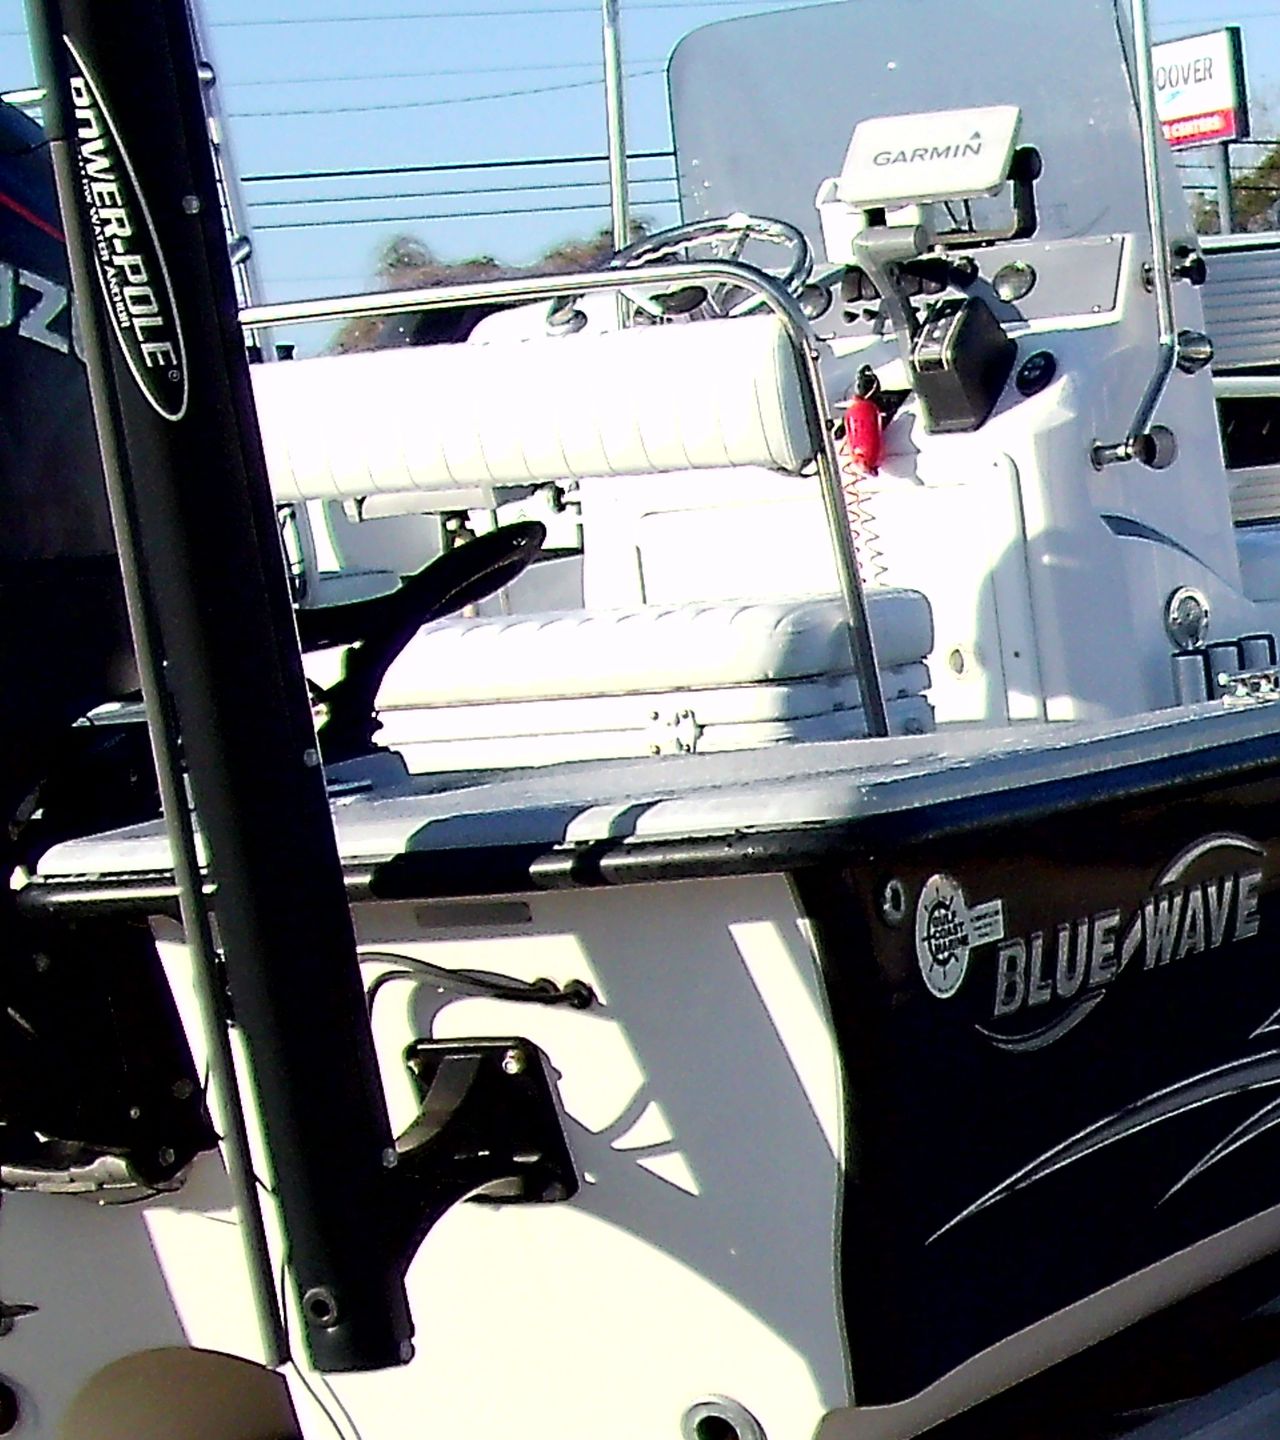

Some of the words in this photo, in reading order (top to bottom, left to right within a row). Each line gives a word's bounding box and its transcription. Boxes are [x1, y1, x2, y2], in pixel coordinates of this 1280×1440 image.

[1155, 56, 1213, 91] OOVER
[873, 142, 982, 166] GARMIN
[932, 909, 957, 928] GULF
[932, 920, 965, 941] COAST
[994, 908, 1120, 1017] BLUE
[1141, 867, 1262, 970] WAVE
